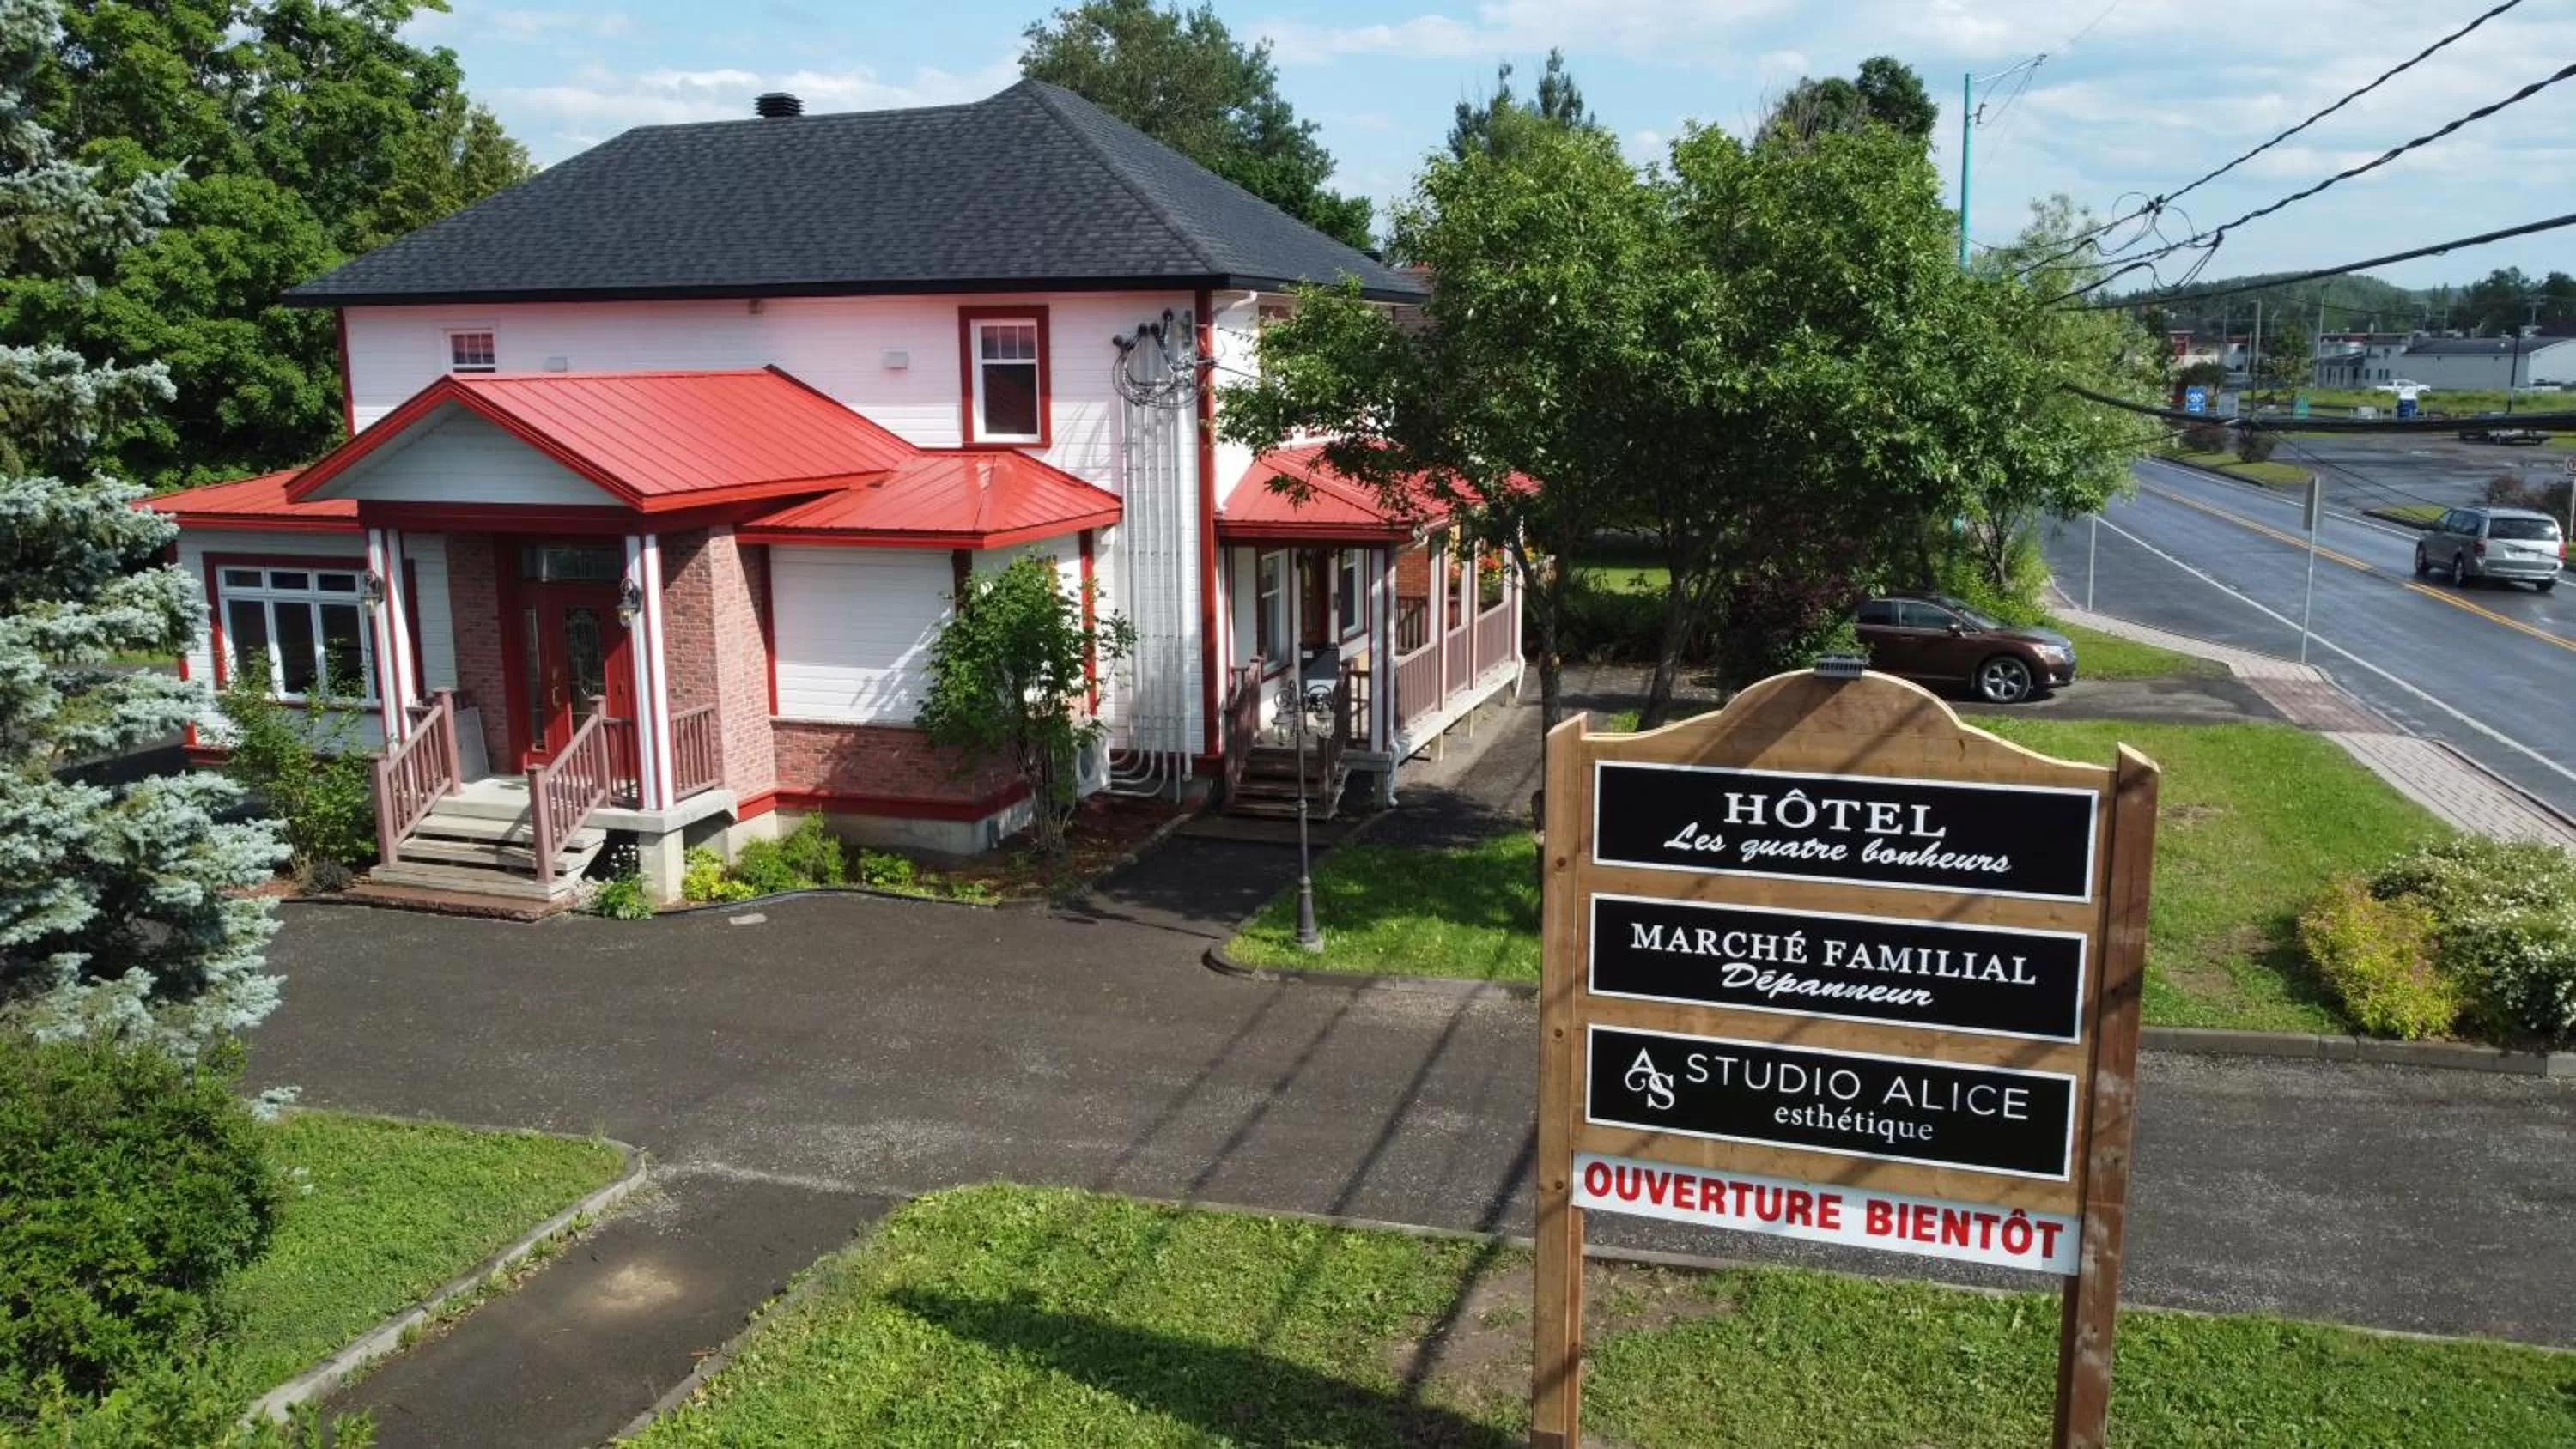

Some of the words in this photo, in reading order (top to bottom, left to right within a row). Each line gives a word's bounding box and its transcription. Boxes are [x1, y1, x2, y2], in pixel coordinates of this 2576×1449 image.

[1722, 787, 1947, 838] HÔTEL
[1663, 822, 1727, 853] Les
[1740, 836, 1849, 863] quatre
[1861, 836, 2011, 874] bonheurs
[1630, 921, 1808, 965] MARCHÉ
[1822, 939, 2037, 985] FAMILIAL
[1721, 962, 1934, 1008] Dépanneur
[1686, 1052, 1862, 1101] STUDIO
[1881, 1075, 2030, 1121] ALICE
[1773, 1102, 1934, 1144] esthétique
[1583, 1161, 1842, 1231] OUVERTURE
[1864, 1198, 2064, 1260] BIENTÔT
